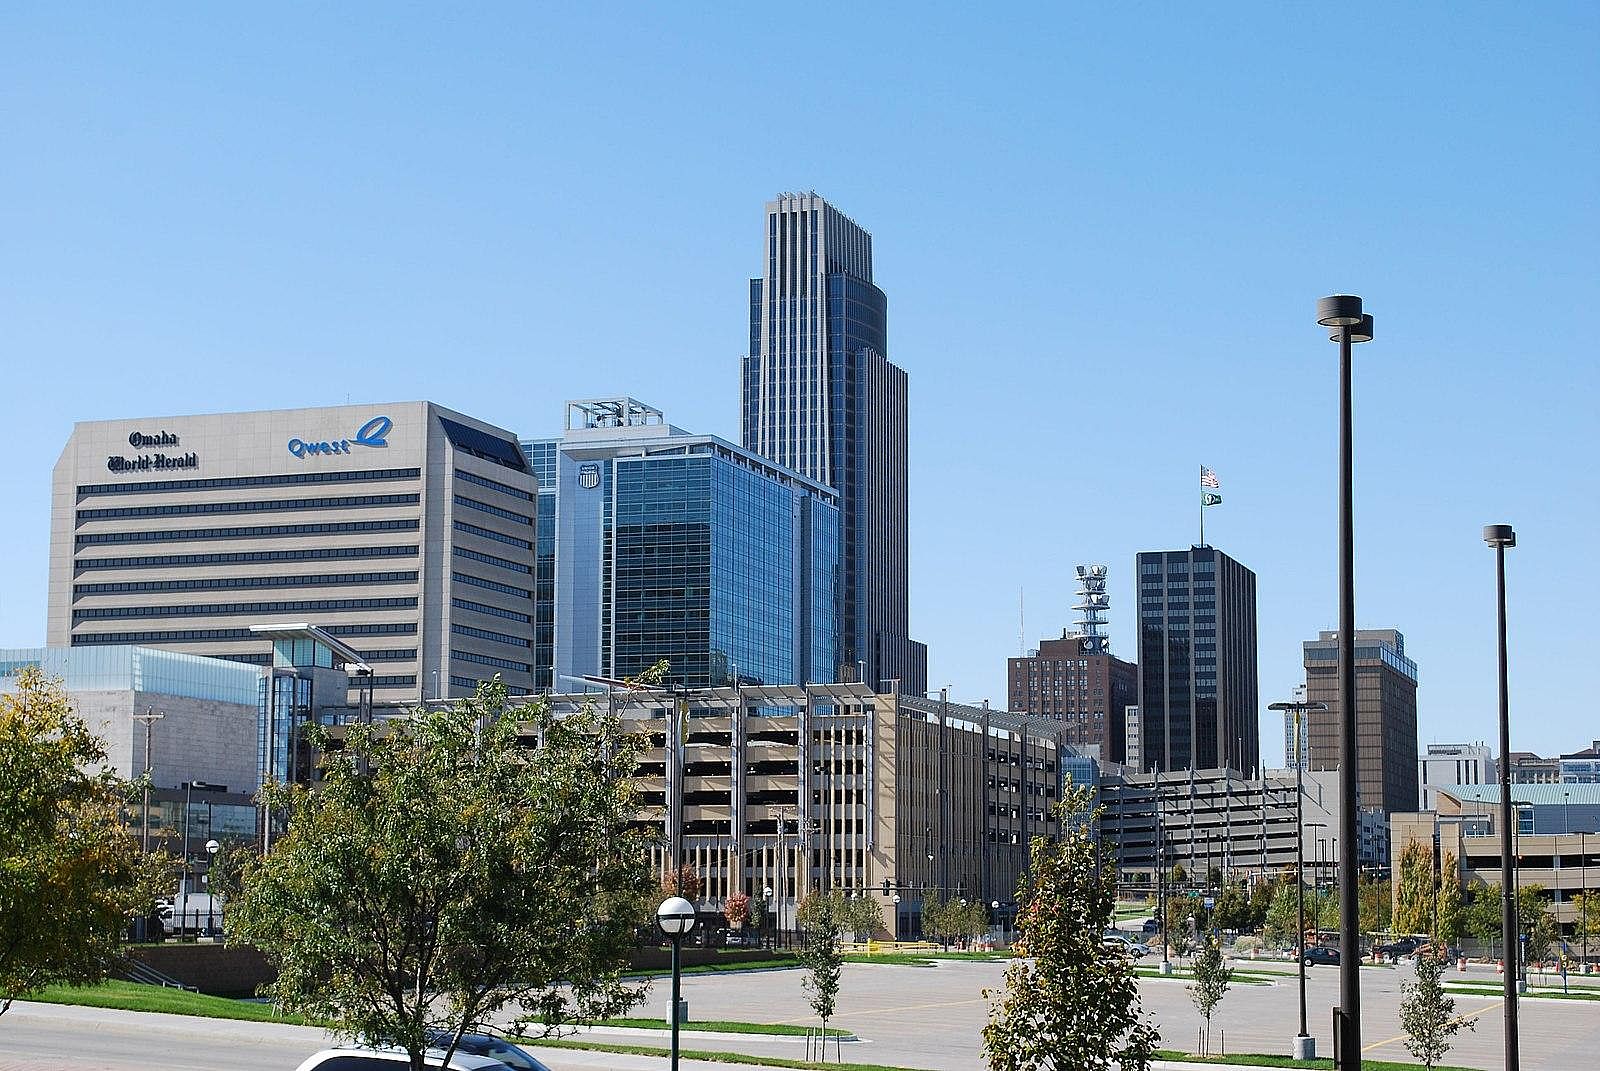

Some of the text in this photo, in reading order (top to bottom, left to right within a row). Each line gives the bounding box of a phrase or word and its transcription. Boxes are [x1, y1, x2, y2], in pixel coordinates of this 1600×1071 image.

[128, 430, 178, 448] Omaha
[288, 438, 351, 459] Qwest
[107, 451, 198, 473] World-Herald
